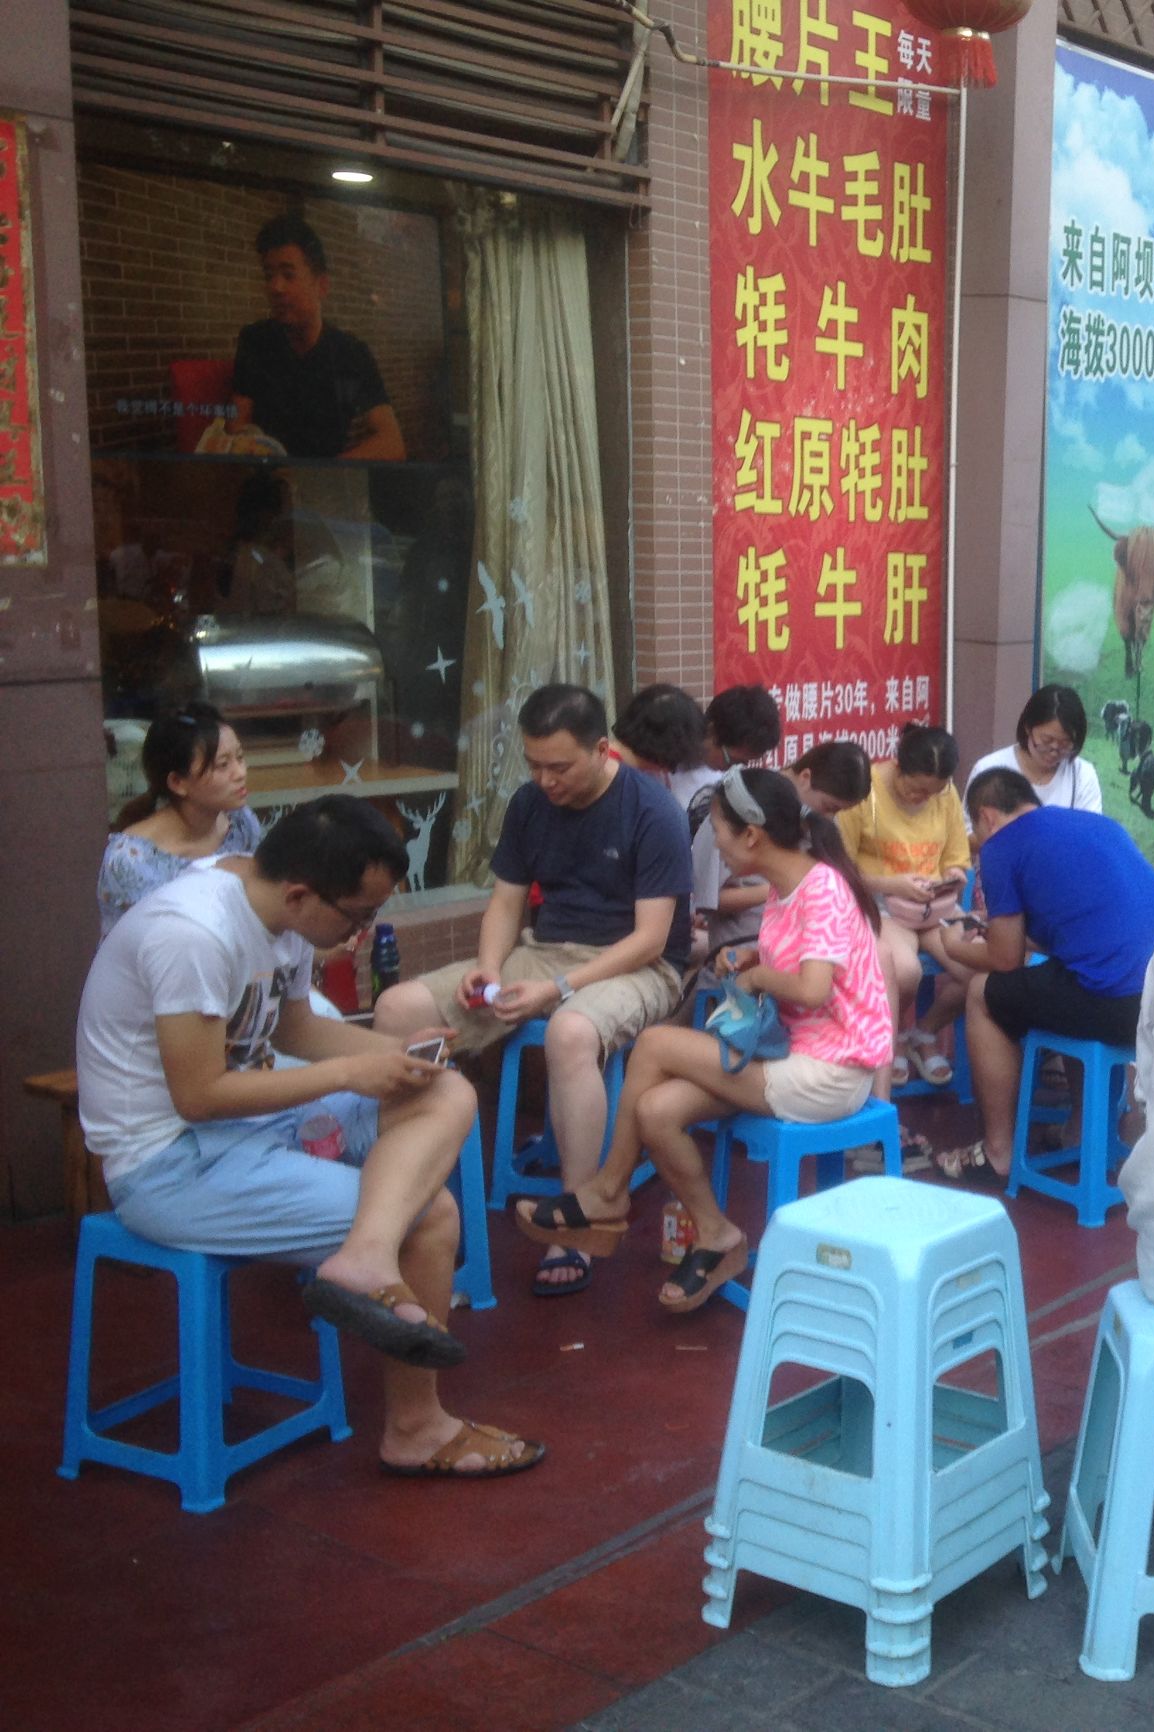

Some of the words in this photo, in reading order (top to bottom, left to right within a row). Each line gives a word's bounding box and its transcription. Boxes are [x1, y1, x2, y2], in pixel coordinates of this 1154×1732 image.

[731, 0, 893, 116] 腰片王
[897, 29, 932, 75] 每天
[897, 76, 932, 121] 限量
[731, 118, 932, 263] 水牛毛肚
[735, 265, 928, 399] 牦牛肉
[734, 408, 929, 523] 红原牦肚
[736, 546, 929, 653] 牦牛肝
